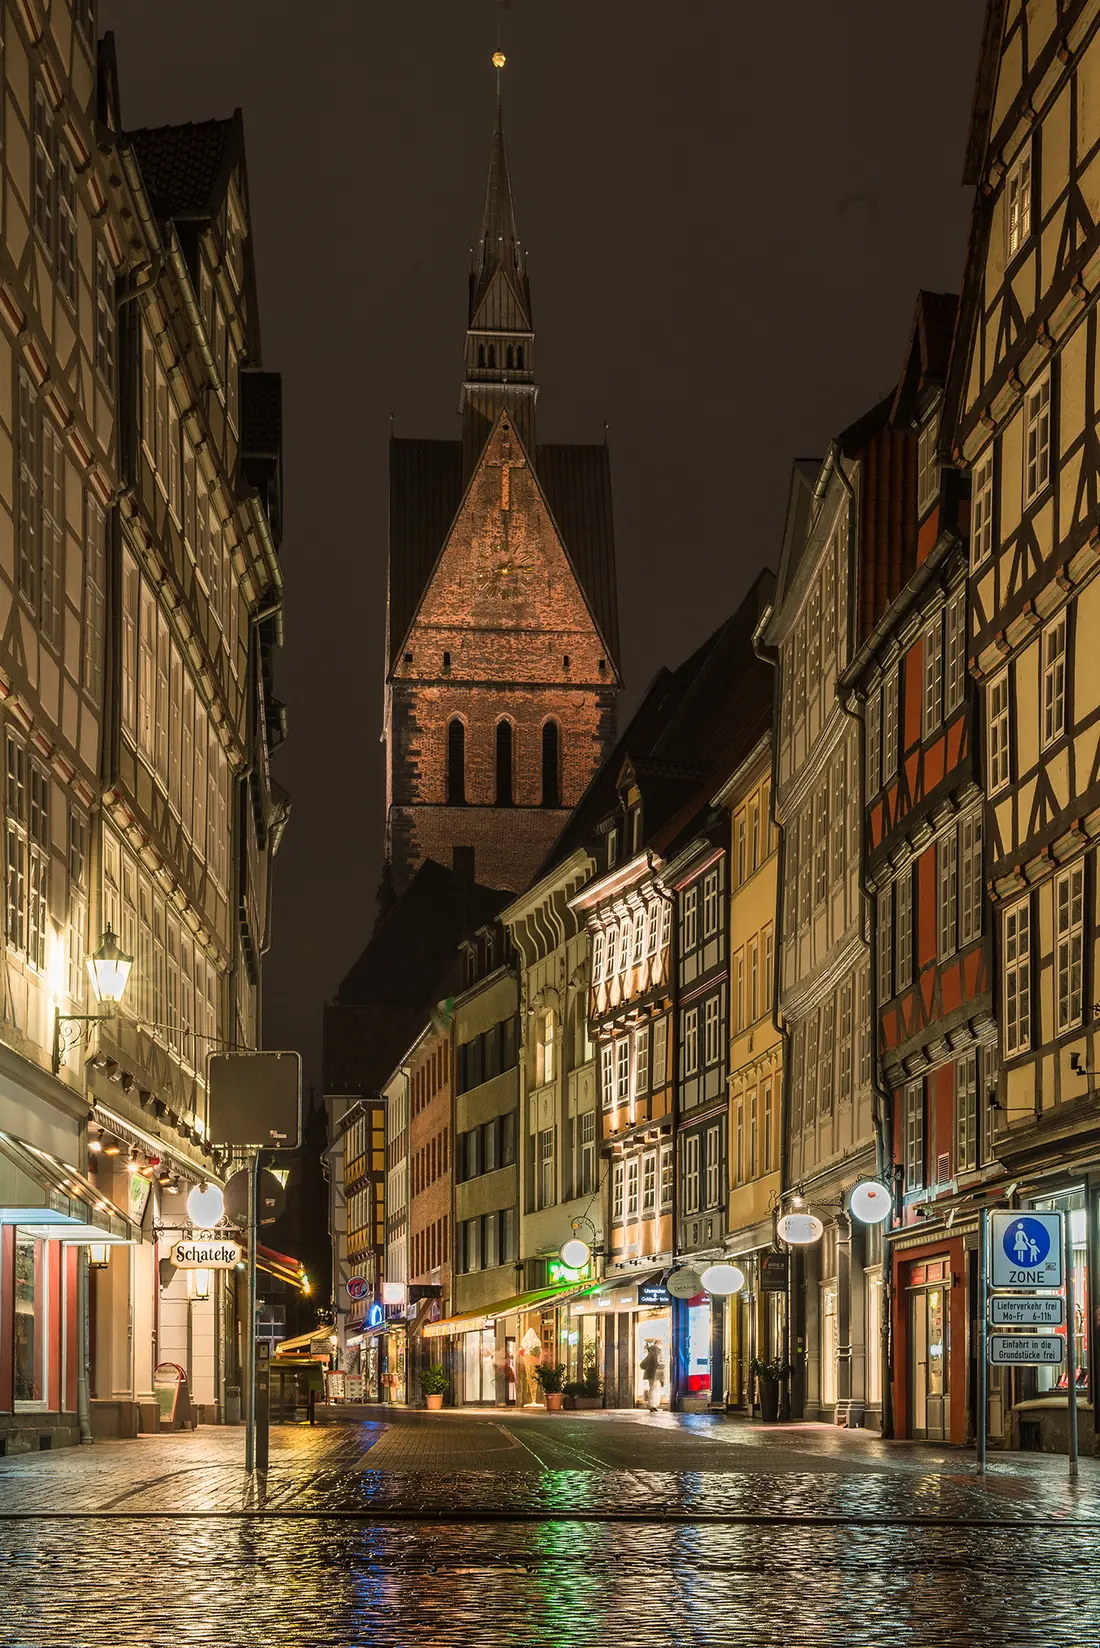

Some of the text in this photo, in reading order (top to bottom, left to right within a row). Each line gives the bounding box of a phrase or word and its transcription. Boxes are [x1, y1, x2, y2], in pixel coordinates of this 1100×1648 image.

[176, 1246, 236, 1263] Schateke
[1009, 1271, 1045, 1283] ZONE
[997, 1302, 1057, 1310] Lieferverkehr frei
[1003, 1312, 1052, 1320] Mo-Fr 6-11h
[1002, 1340, 1052, 1349] Einfahrt in die
[998, 1350, 1055, 1360] Grundstücke frei
